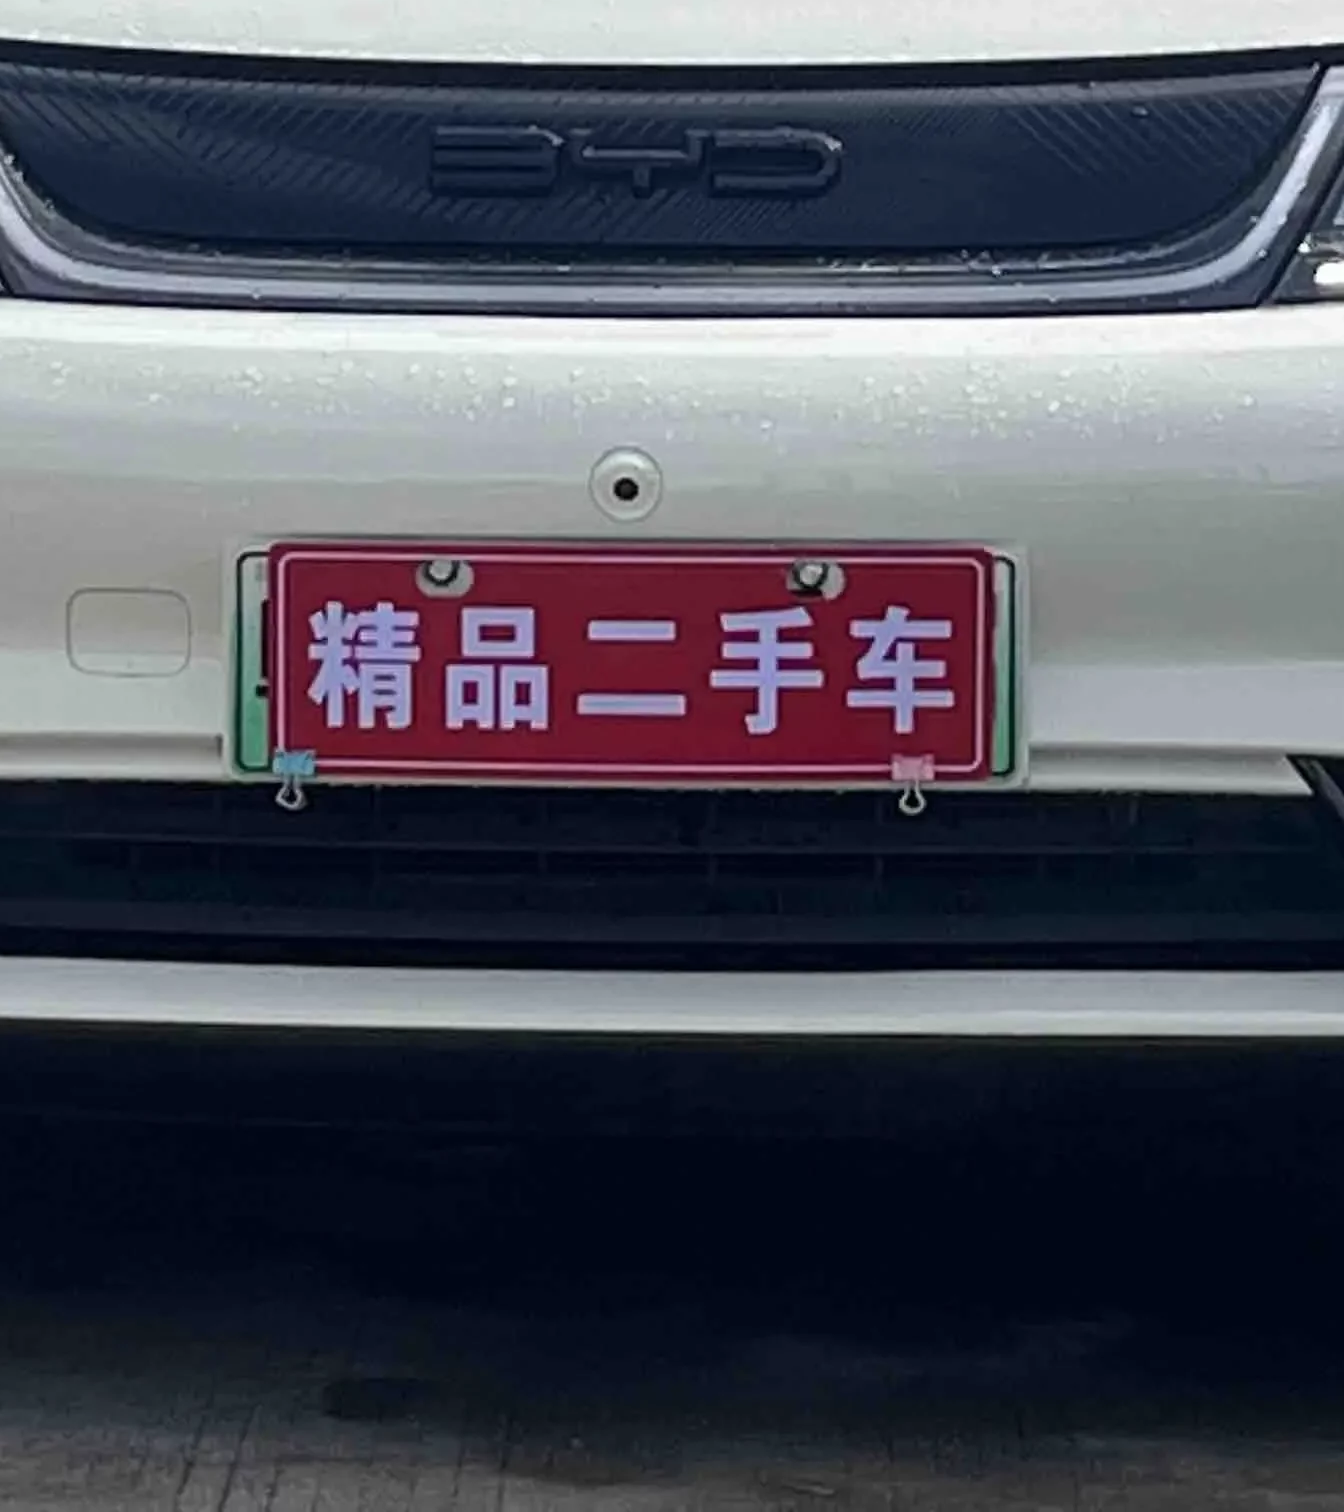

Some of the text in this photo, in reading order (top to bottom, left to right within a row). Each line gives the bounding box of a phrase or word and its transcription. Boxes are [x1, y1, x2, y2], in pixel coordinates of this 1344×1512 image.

[430, 123, 843, 198] BYD
[307, 601, 956, 736] 精品二手车
